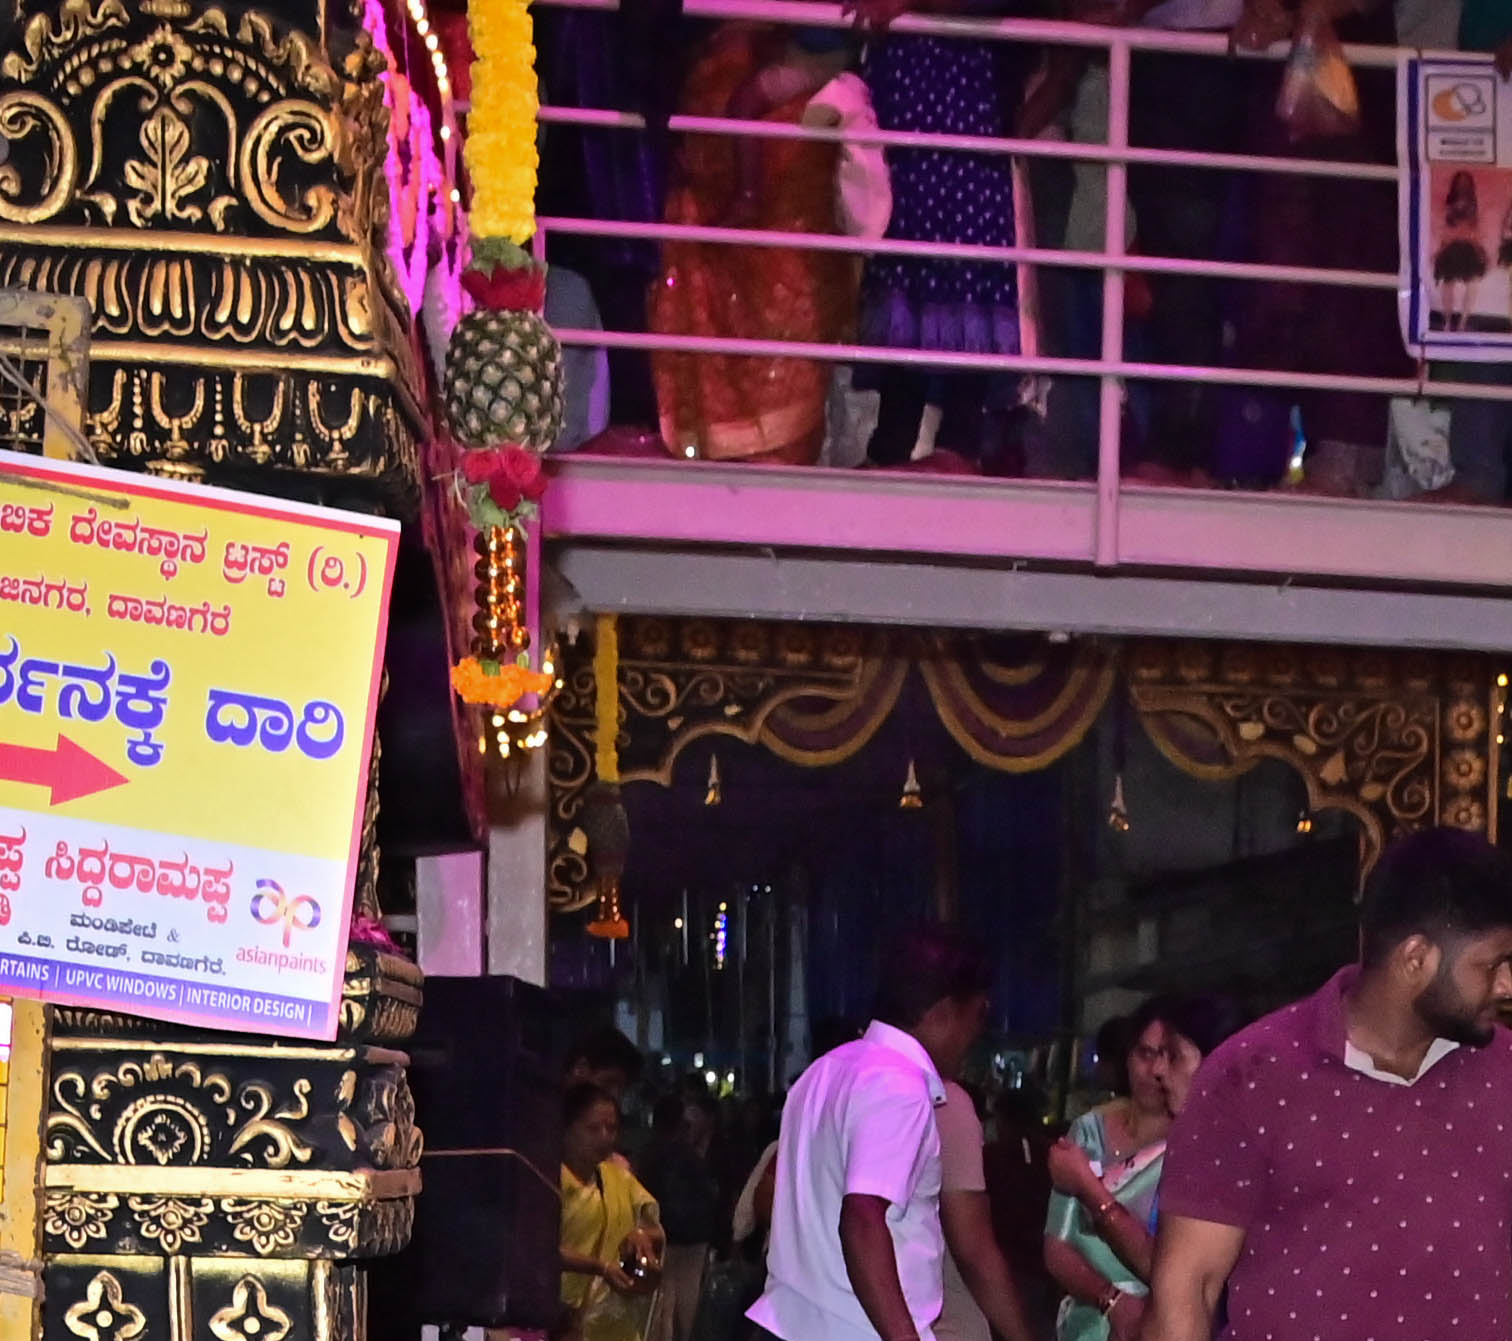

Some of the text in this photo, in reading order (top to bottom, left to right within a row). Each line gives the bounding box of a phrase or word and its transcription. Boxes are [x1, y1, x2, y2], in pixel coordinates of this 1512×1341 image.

[69, 506, 208, 581] ದೇವಸ್ಥಾನ
[223, 541, 290, 598] ಟ್ರಸ್ಟ್
[307, 545, 368, 599] (ರಿ.)
[107, 594, 232, 636] ದಾವಣಗೆರೆ
[205, 687, 346, 759] ದಾರಿ
[236, 945, 328, 975] asianpaints
[65, 969, 103, 990] UPVC
[107, 975, 177, 1002] WINDOWS
[187, 987, 251, 1013] INTERIOR
[254, 996, 306, 1022] DESIGN
